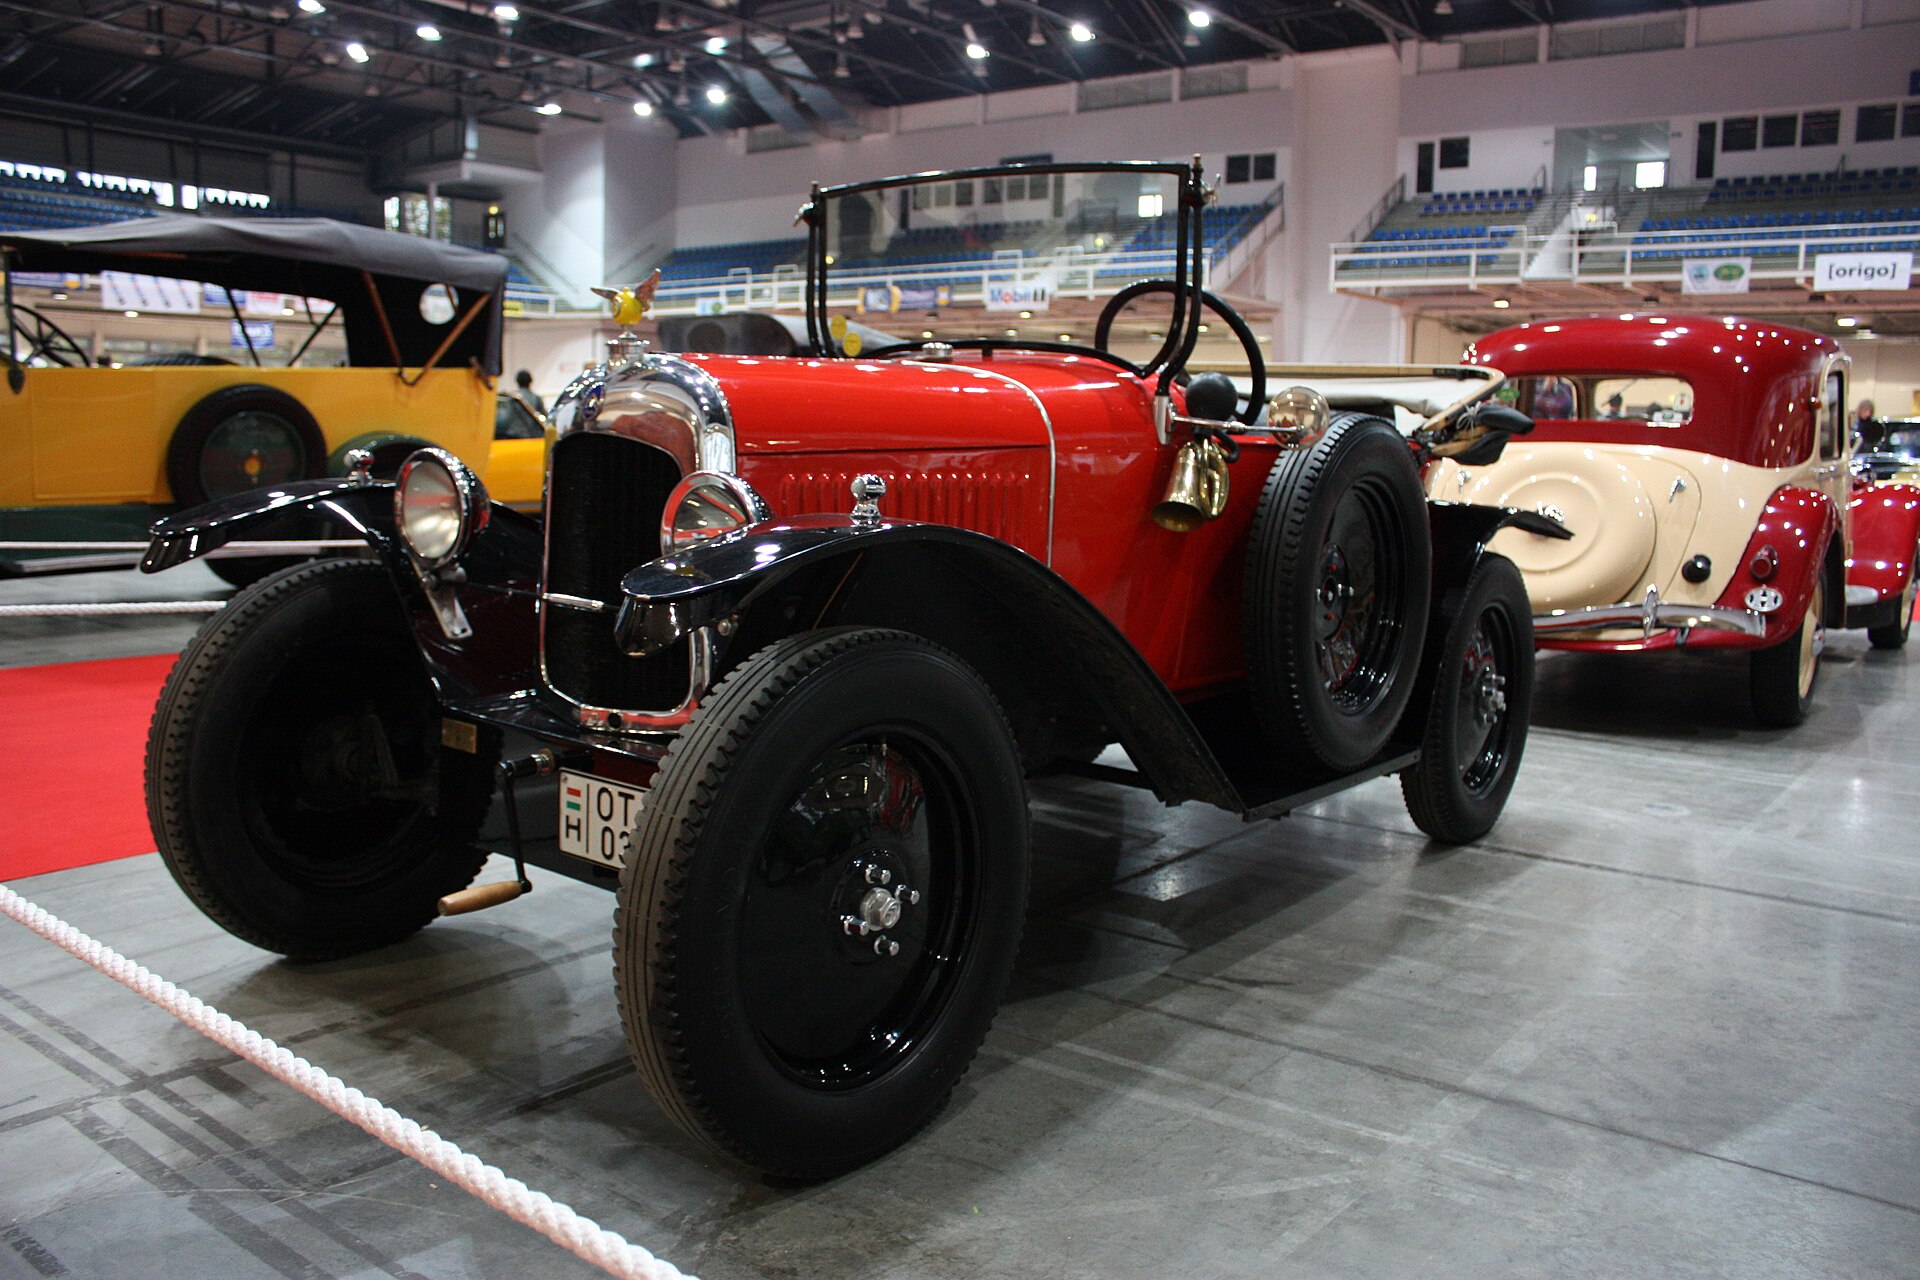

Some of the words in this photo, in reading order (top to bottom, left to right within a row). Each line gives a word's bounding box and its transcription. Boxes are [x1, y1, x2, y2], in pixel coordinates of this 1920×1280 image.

[1828, 262, 1897, 280] [origo]
[597, 787, 635, 826] OT
[565, 815, 581, 841] H
